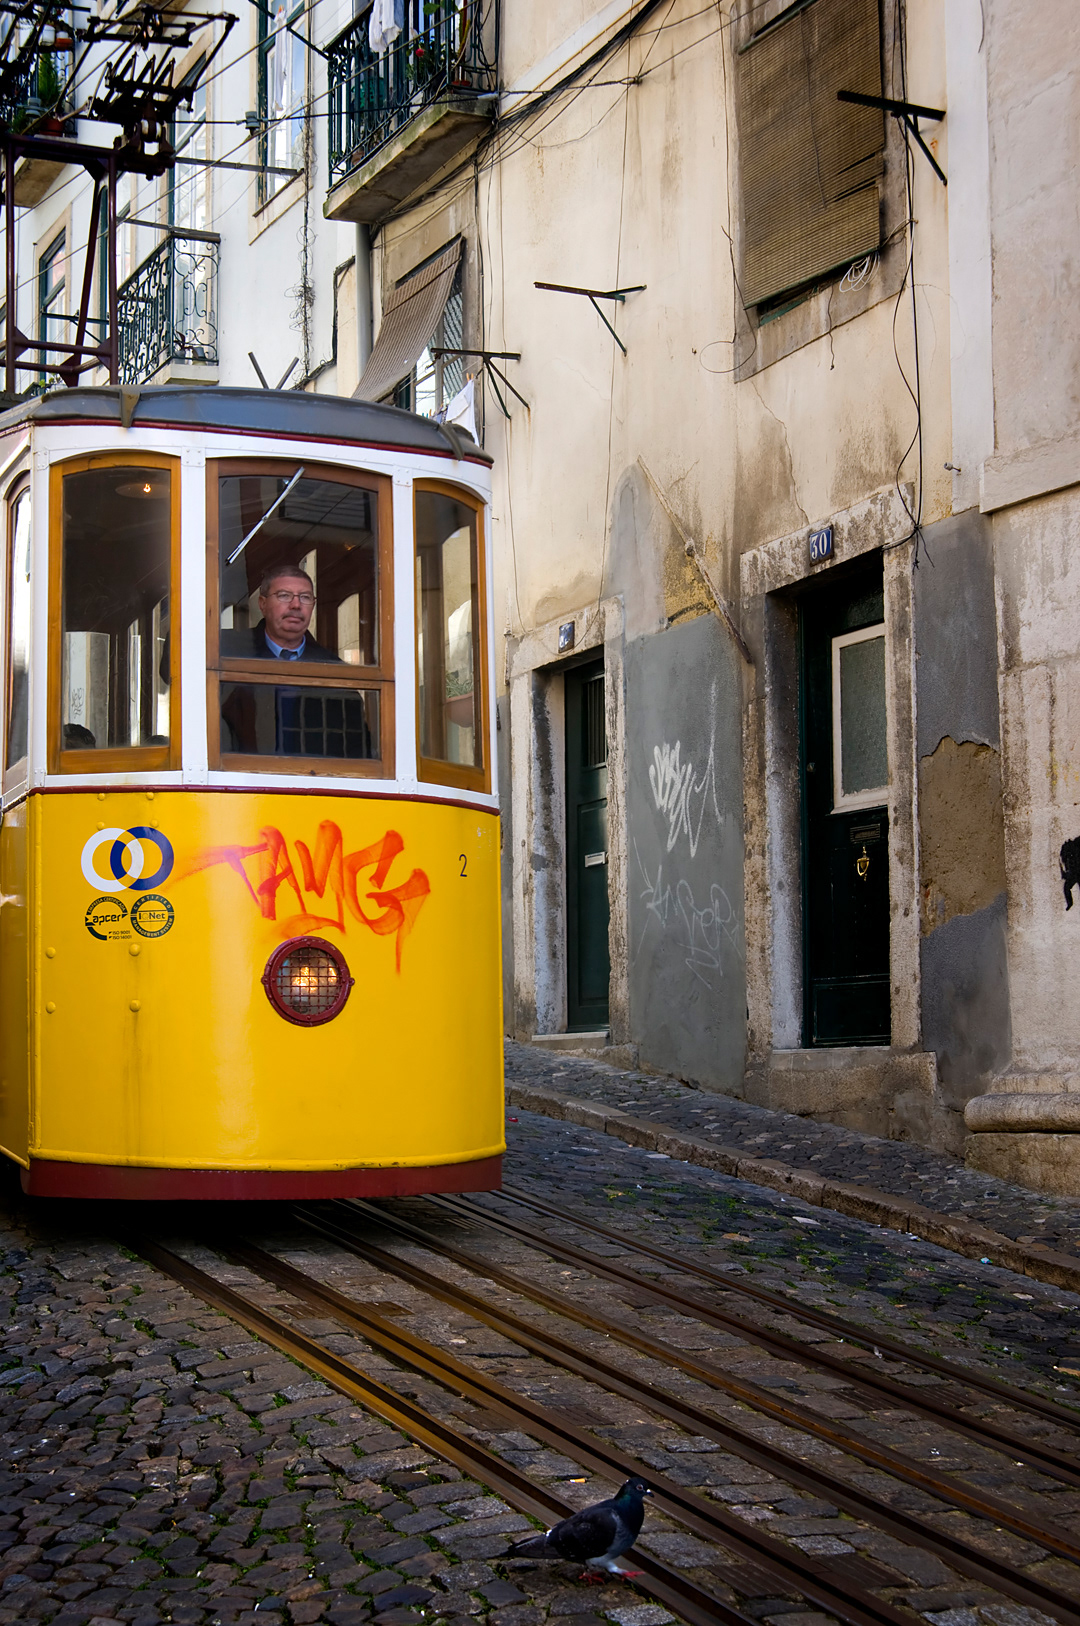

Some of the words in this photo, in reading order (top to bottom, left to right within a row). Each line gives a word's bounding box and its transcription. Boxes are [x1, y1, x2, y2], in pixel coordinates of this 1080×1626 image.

[811, 532, 828, 559] 30
[459, 854, 467, 877] 2
[133, 895, 171, 910] CERTIFIED
[92, 914, 122, 926] apcer
[132, 919, 160, 937] MANAGEMENT
[161, 917, 173, 935] SYSTEM
